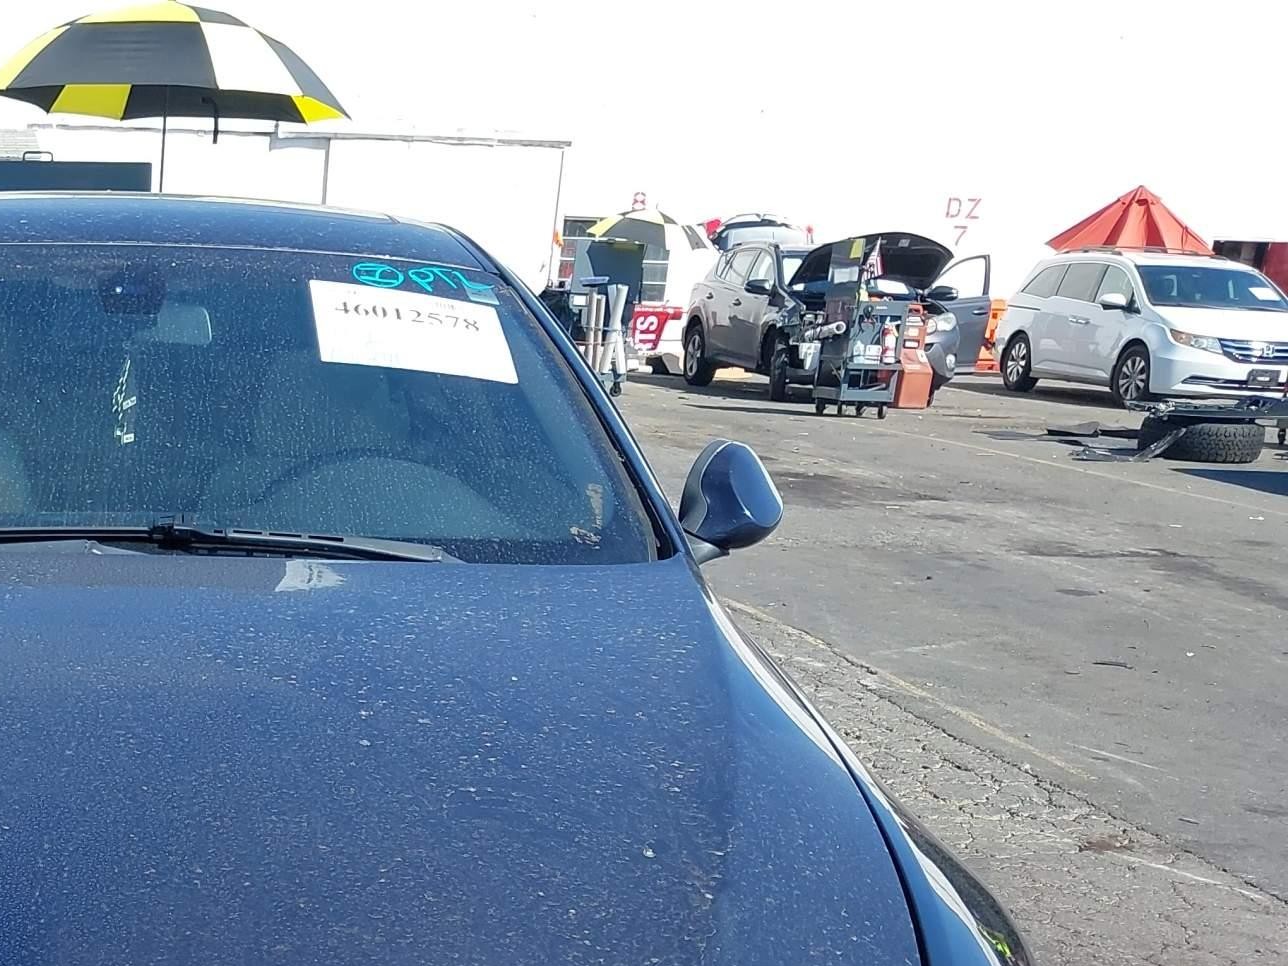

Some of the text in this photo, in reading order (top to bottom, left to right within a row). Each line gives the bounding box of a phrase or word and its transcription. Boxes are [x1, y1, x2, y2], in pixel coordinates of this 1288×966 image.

[945, 197, 982, 219] DZ
[954, 225, 968, 246] 7
[334, 301, 480, 332] 46012578
